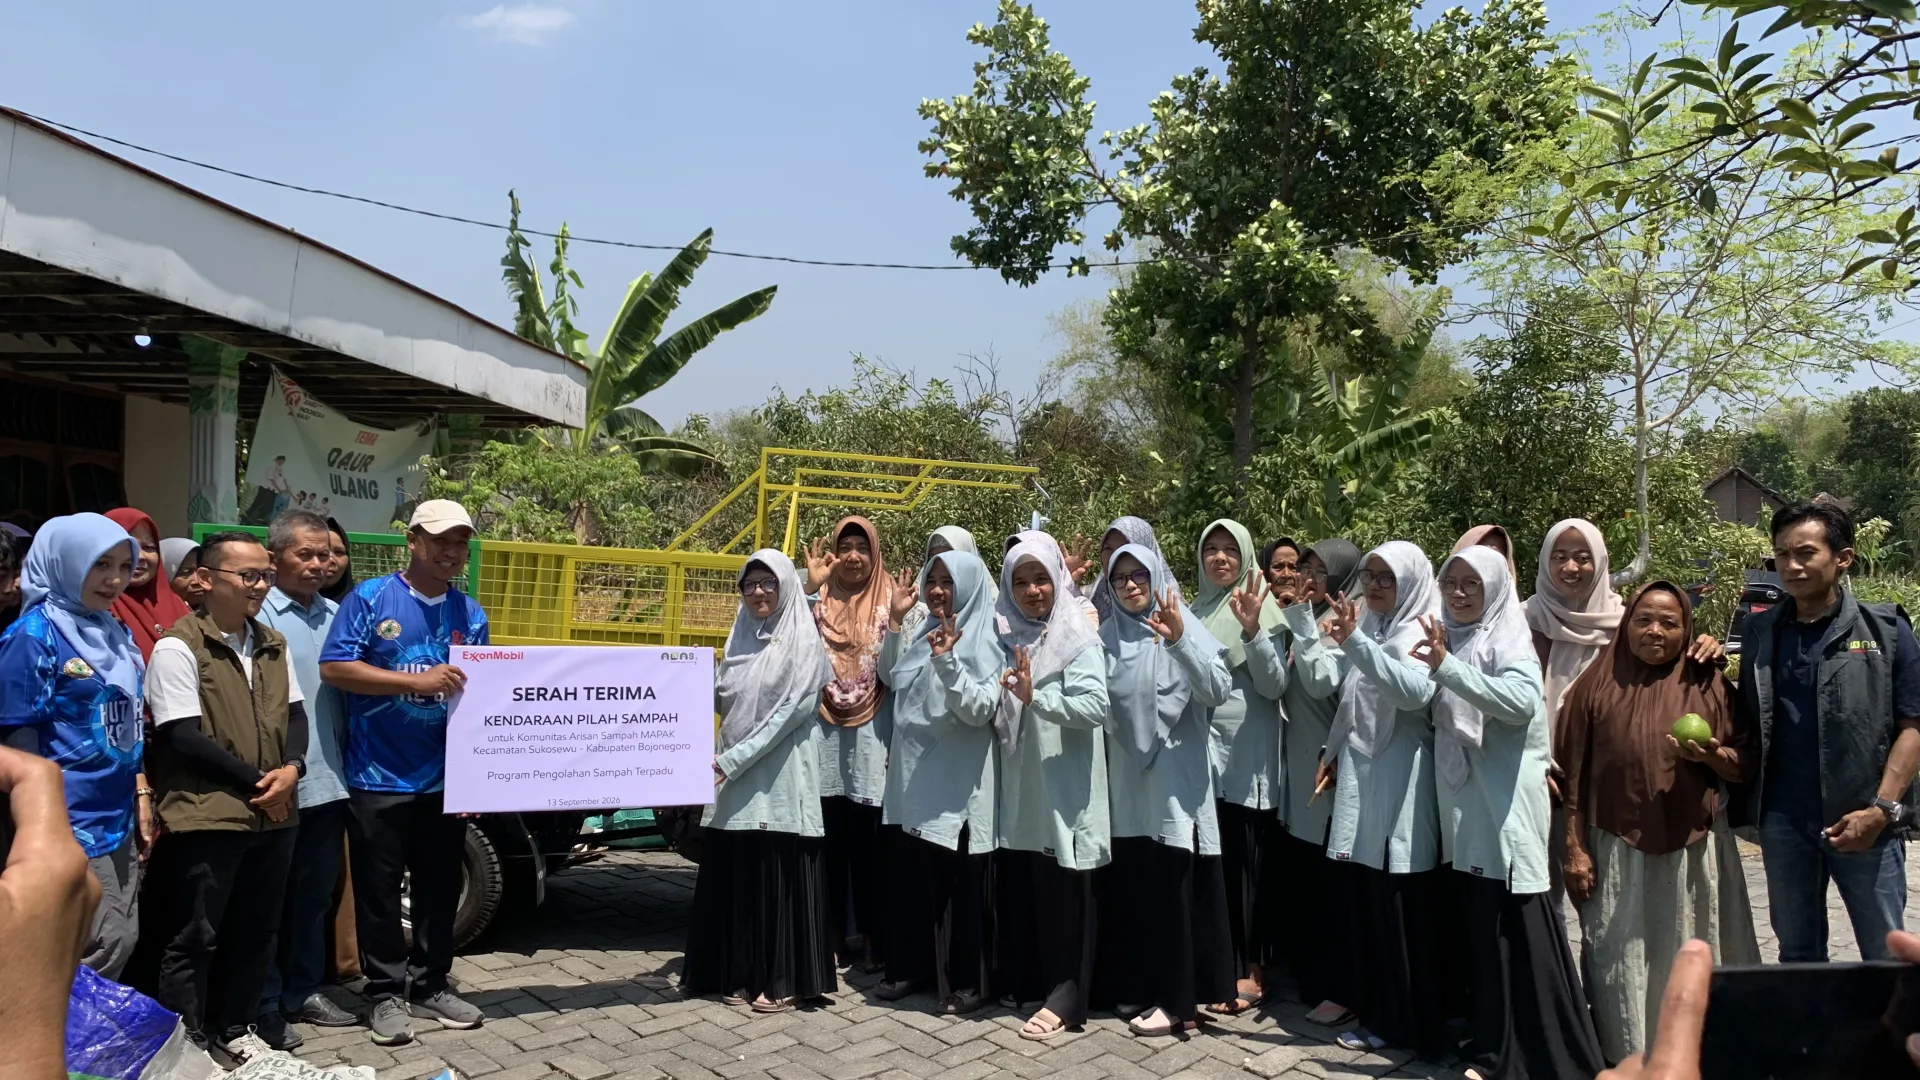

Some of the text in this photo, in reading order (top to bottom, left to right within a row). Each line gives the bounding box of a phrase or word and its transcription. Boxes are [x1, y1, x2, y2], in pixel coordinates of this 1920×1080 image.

[355, 430, 379, 446] TEMA
[329, 473, 379, 500] ULANG
[463, 651, 523, 662] ExxonMobil
[513, 686, 656, 701] SERAH TERIMA
[100, 701, 128, 725] HUT
[484, 713, 678, 726] KENDARAAN PILAH SAMPAH
[488, 730, 675, 742] untuk Komunitas Arisan Sampah MAPAK
[473, 746, 525, 755] Kecamatan
[529, 745, 576, 754] Sukosewu
[587, 744, 635, 754] Kabupaten
[638, 743, 690, 753] Bojonegoro
[488, 766, 673, 782] Program Pengolahan Sampah Terpadu
[558, 798, 601, 808] September
